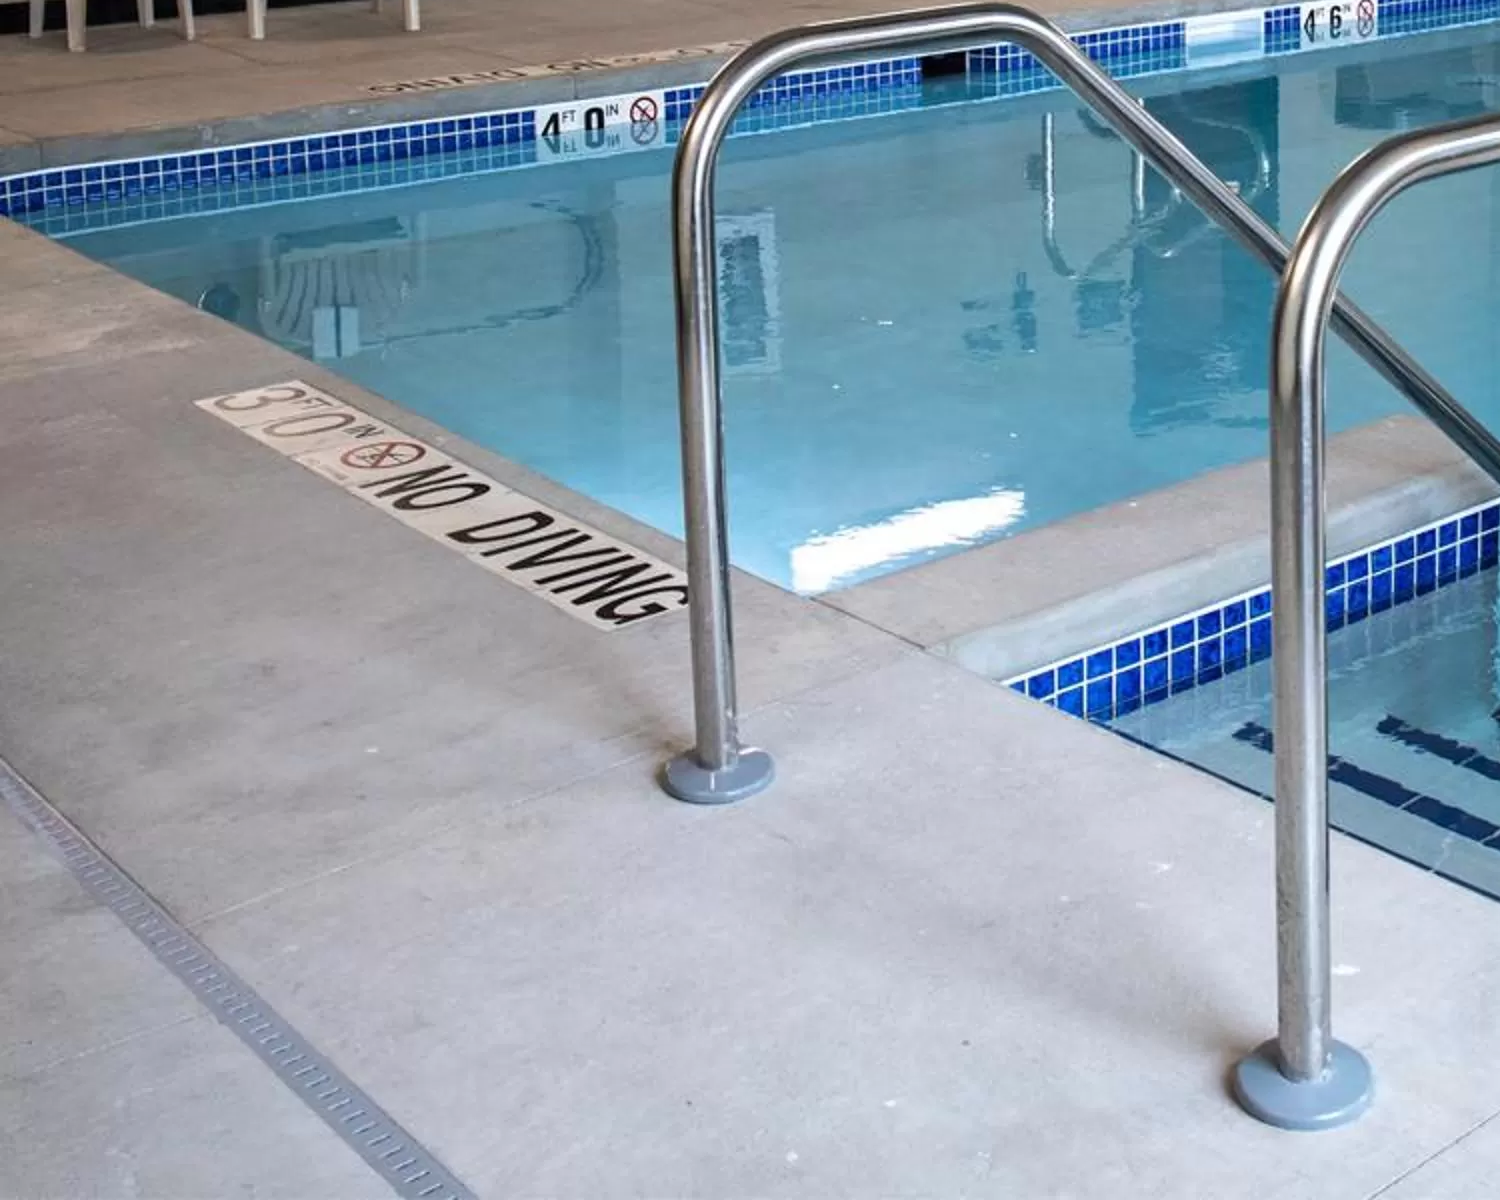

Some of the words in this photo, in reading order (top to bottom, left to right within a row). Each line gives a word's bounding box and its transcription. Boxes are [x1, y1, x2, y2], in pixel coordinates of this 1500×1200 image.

[541, 112, 561, 137] 4
[584, 106, 605, 131] 0
[213, 387, 307, 411] 3
[262, 413, 356, 437] 0
[360, 464, 491, 511] NO
[446, 510, 689, 625] DIVING
